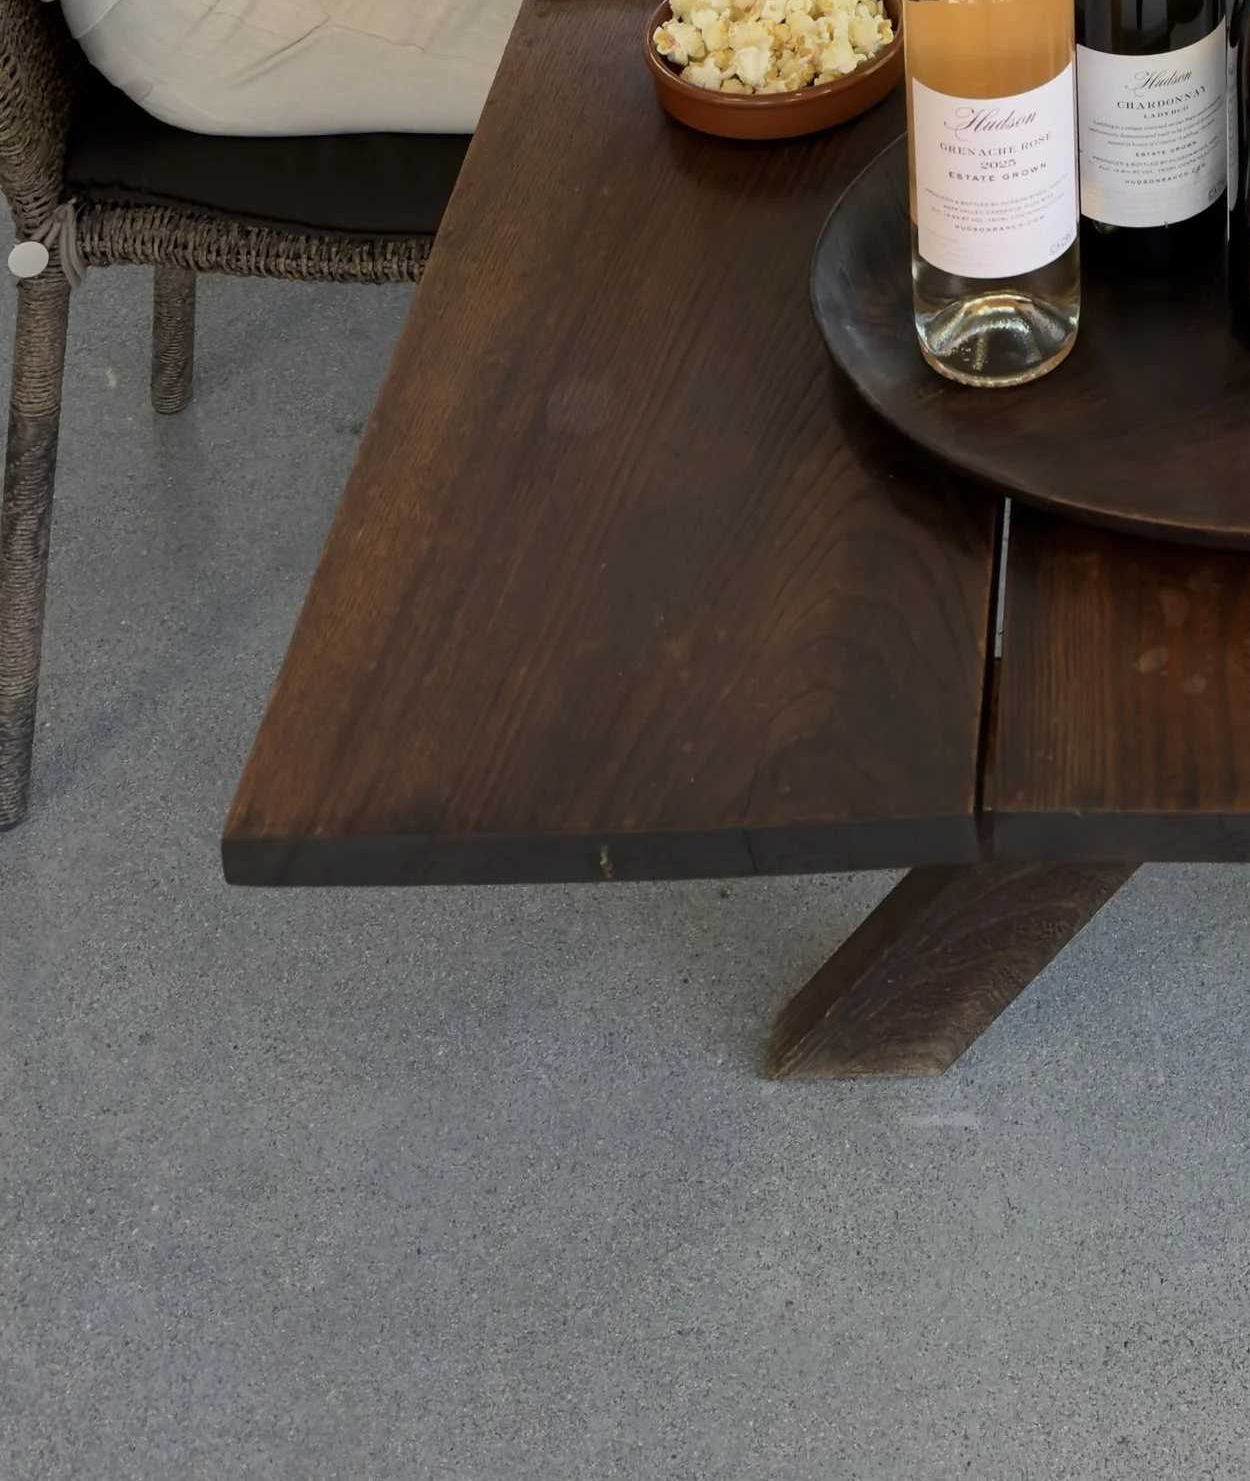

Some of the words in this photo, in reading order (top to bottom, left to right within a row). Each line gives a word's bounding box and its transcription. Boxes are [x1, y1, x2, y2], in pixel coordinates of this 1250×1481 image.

[1125, 69, 1193, 97] Hudson
[1117, 83, 1209, 110] CHARDONNAY
[1143, 106, 1189, 119] LADYBUG
[944, 107, 1037, 142] Hudson
[940, 141, 1017, 157] GRENACHE
[1135, 149, 1167, 157] ESTATE
[1170, 140, 1197, 153] GROWN
[948, 171, 996, 182] ESTATE
[1002, 162, 1047, 181] GROWN
[955, 215, 1044, 233] HUDSONRANCH.COM
